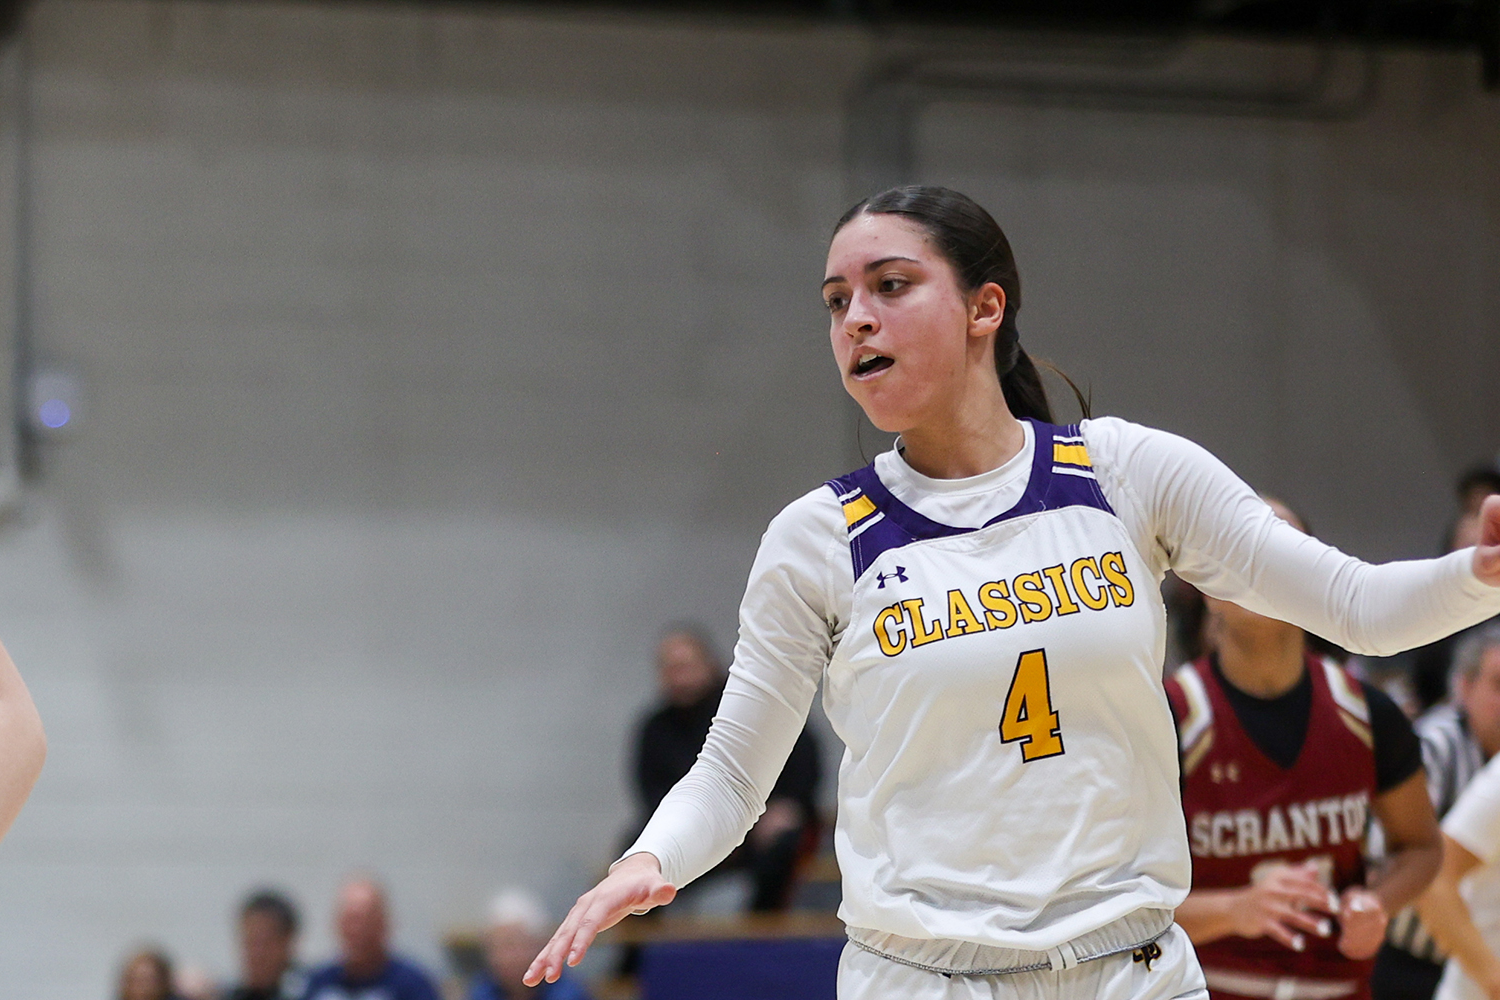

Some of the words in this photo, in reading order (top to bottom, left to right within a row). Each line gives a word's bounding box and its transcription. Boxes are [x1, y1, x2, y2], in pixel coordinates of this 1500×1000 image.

[873, 551, 1135, 657] CLASSICS
[999, 648, 1065, 763] 4
[1190, 788, 1370, 858] SCRANTO
